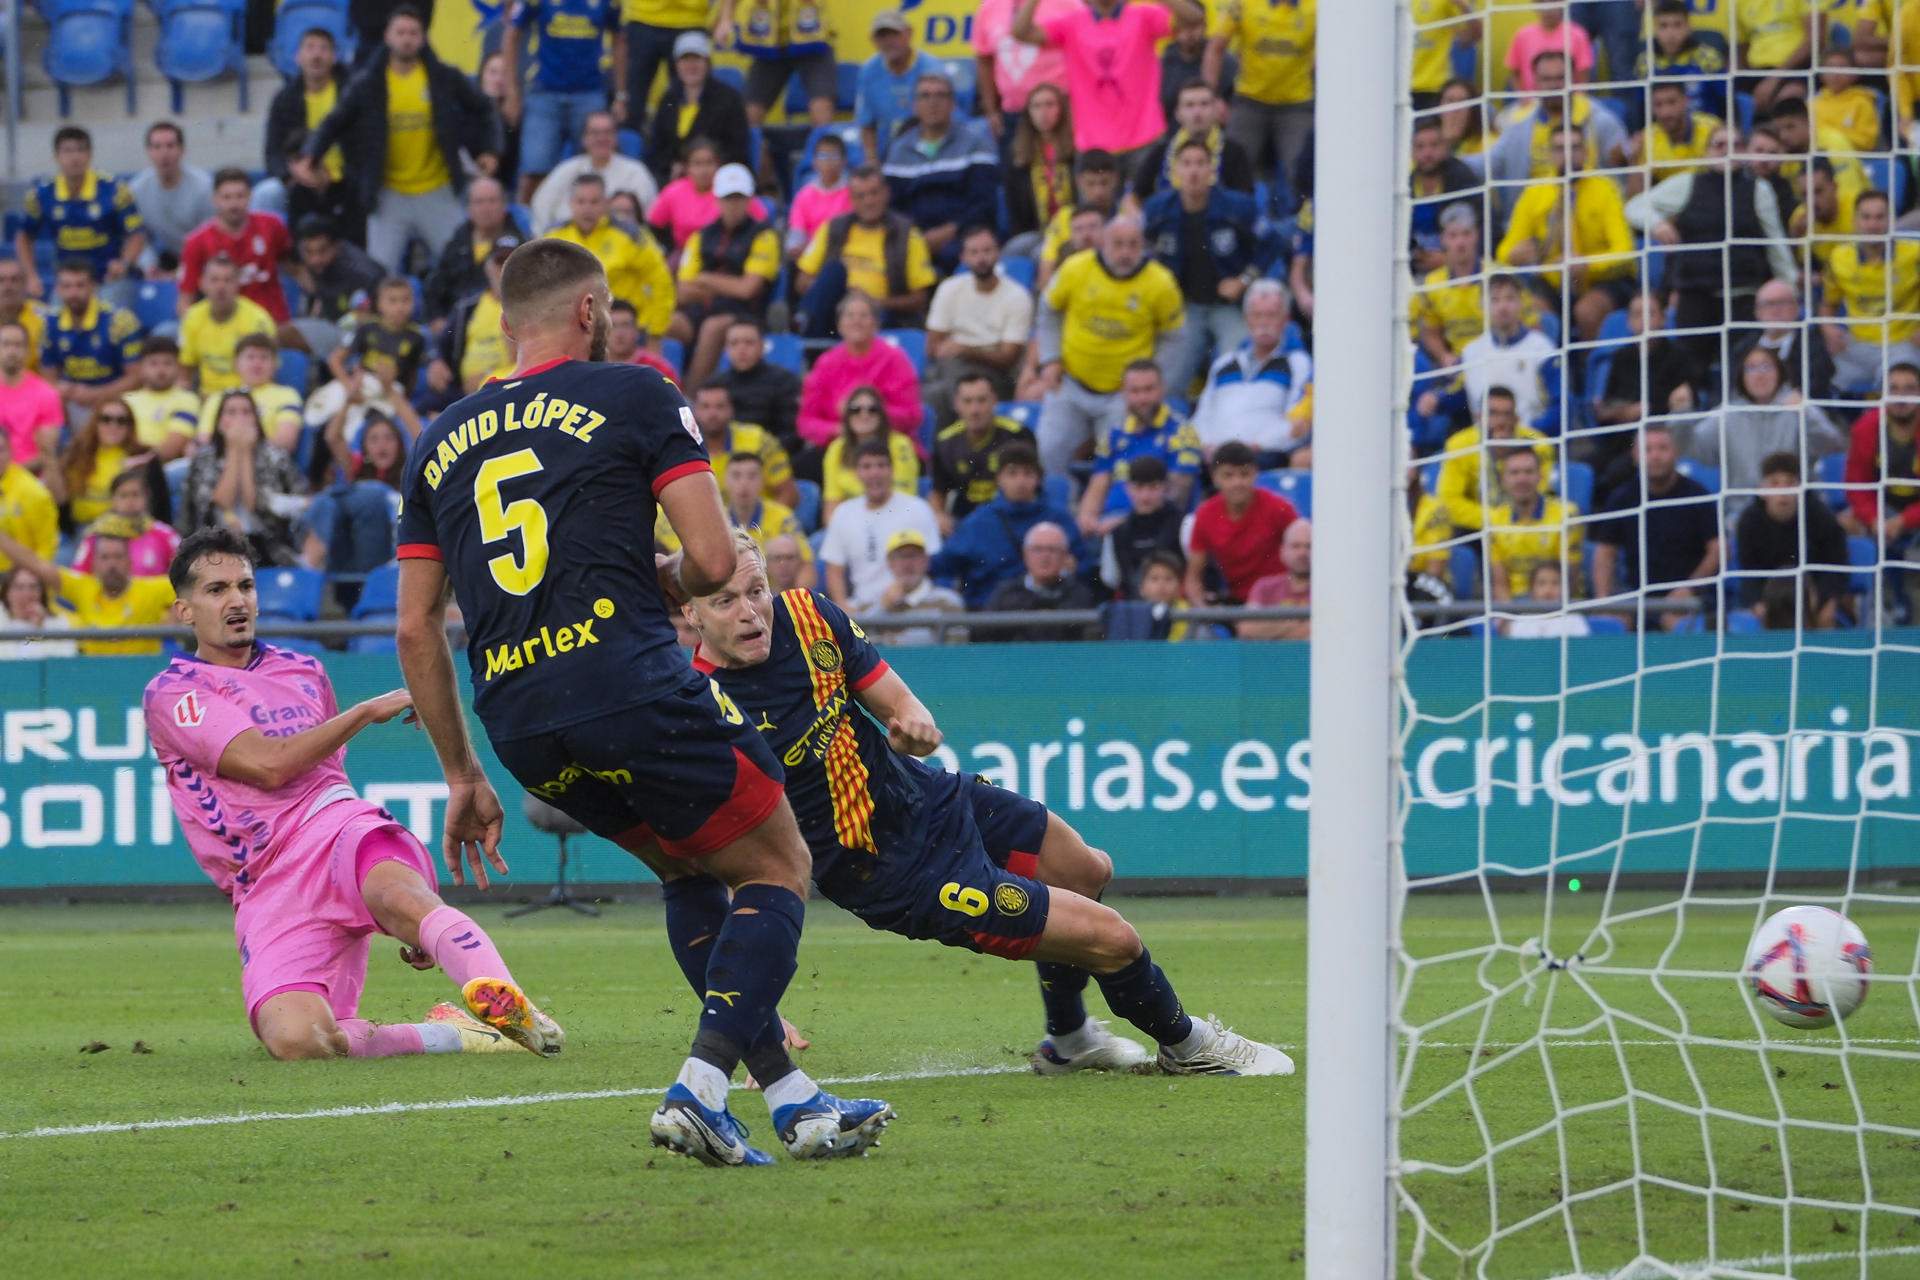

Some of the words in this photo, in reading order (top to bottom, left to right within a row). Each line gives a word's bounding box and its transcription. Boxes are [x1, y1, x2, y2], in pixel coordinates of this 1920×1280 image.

[926, 16, 973, 43] DI
[423, 409, 499, 491] DAVID
[504, 392, 607, 443] LÓPEZ
[474, 447, 549, 596] 5
[485, 618, 600, 681] Marlex
[4, 707, 158, 764] RU
[250, 703, 311, 727] Gran
[1416, 706, 1911, 809] cricanaria
[939, 881, 989, 917] 6
